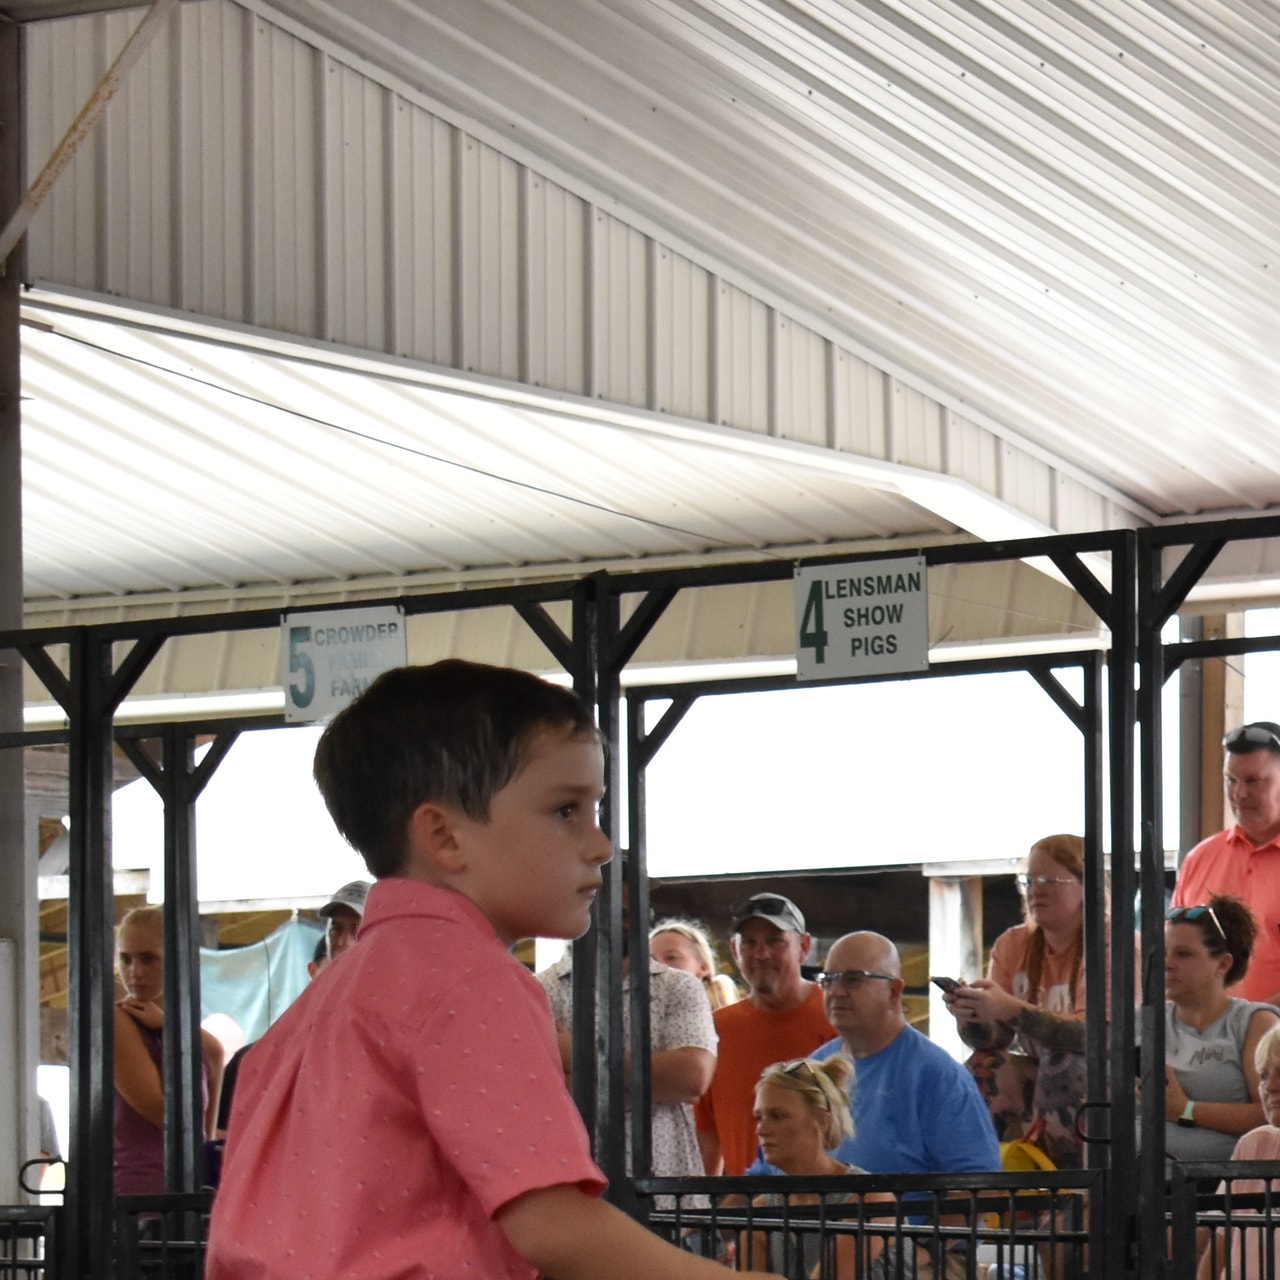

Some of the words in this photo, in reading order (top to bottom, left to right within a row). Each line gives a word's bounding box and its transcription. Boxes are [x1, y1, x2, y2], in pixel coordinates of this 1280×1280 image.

[825, 571, 921, 600] LENSMAN
[800, 580, 828, 664] 4
[843, 603, 904, 628] SHOW
[314, 622, 399, 647] CROWDER
[851, 634, 898, 658] PIGS
[289, 626, 316, 709] 5
[331, 677, 369, 698] FAR
